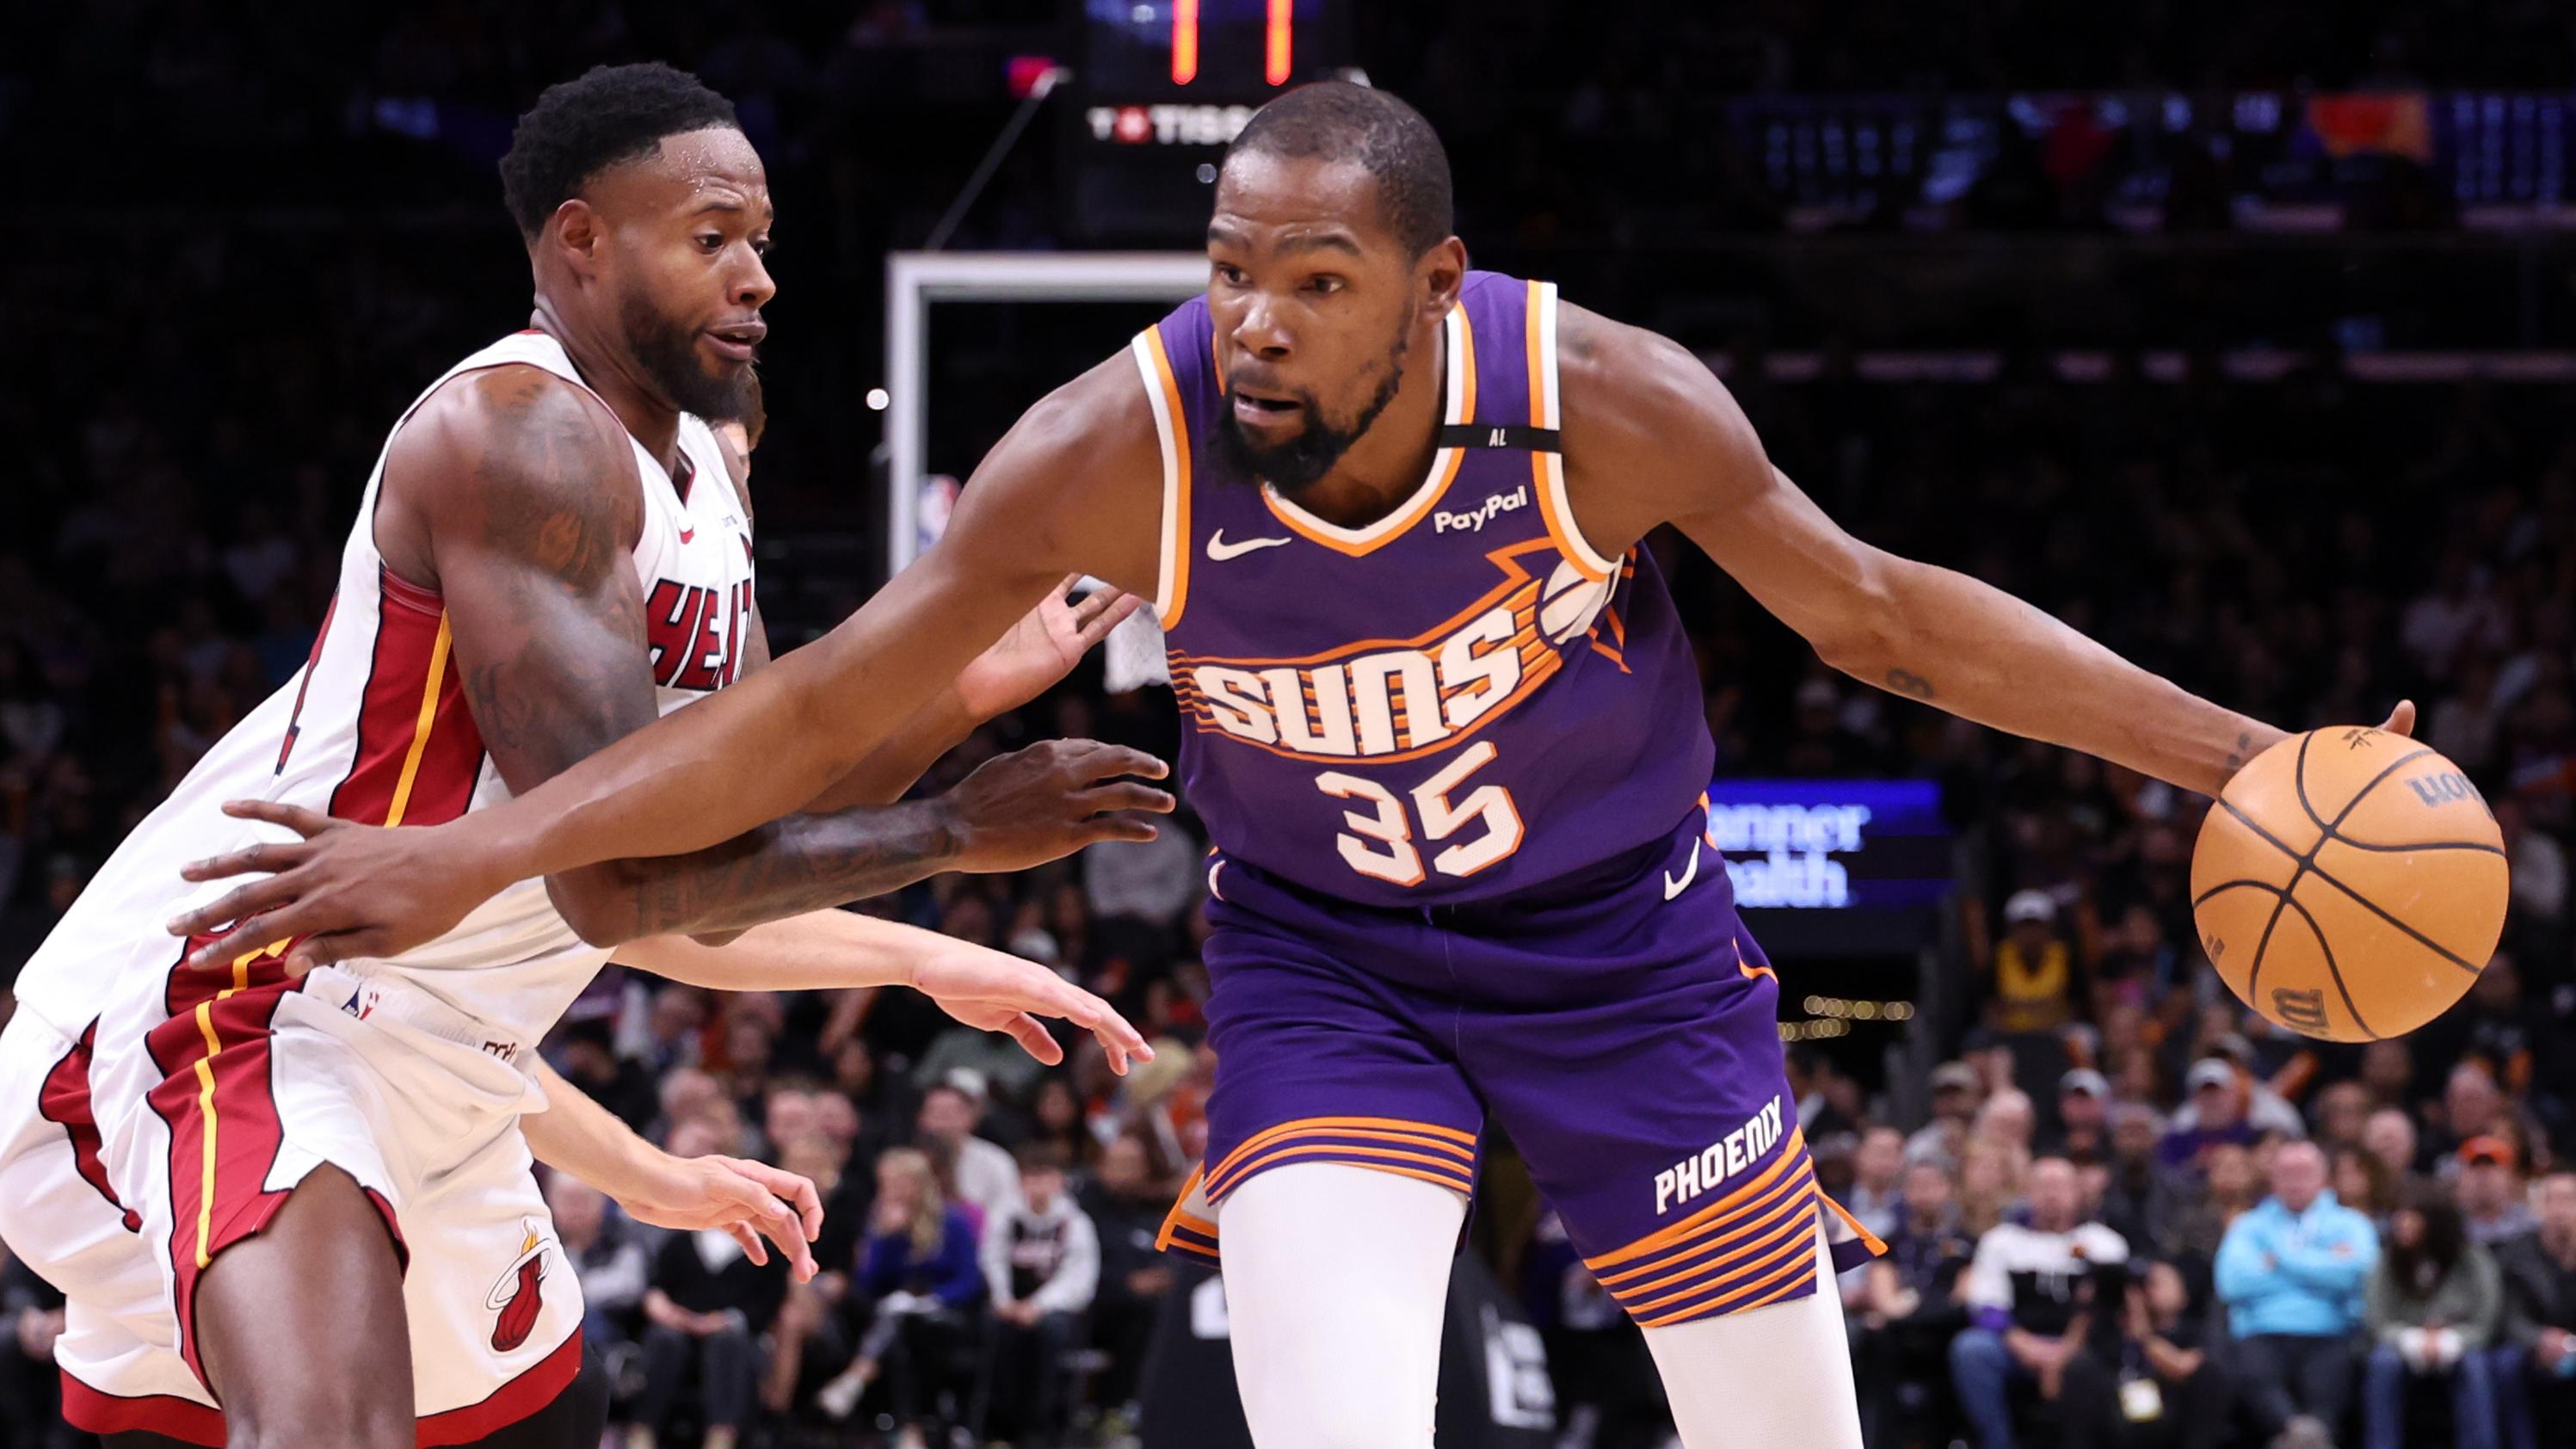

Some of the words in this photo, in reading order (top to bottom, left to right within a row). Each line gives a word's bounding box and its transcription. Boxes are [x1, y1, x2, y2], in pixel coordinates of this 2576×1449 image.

[1488, 428, 1507, 447] AL
[1433, 484, 1528, 533] PayPal
[1192, 607, 1522, 756] SUNS
[1315, 740, 1525, 887] 35
[1707, 803, 1871, 852] anner
[1725, 848, 1849, 909] ealth
[1654, 1094, 1783, 1216] PHOENIX
